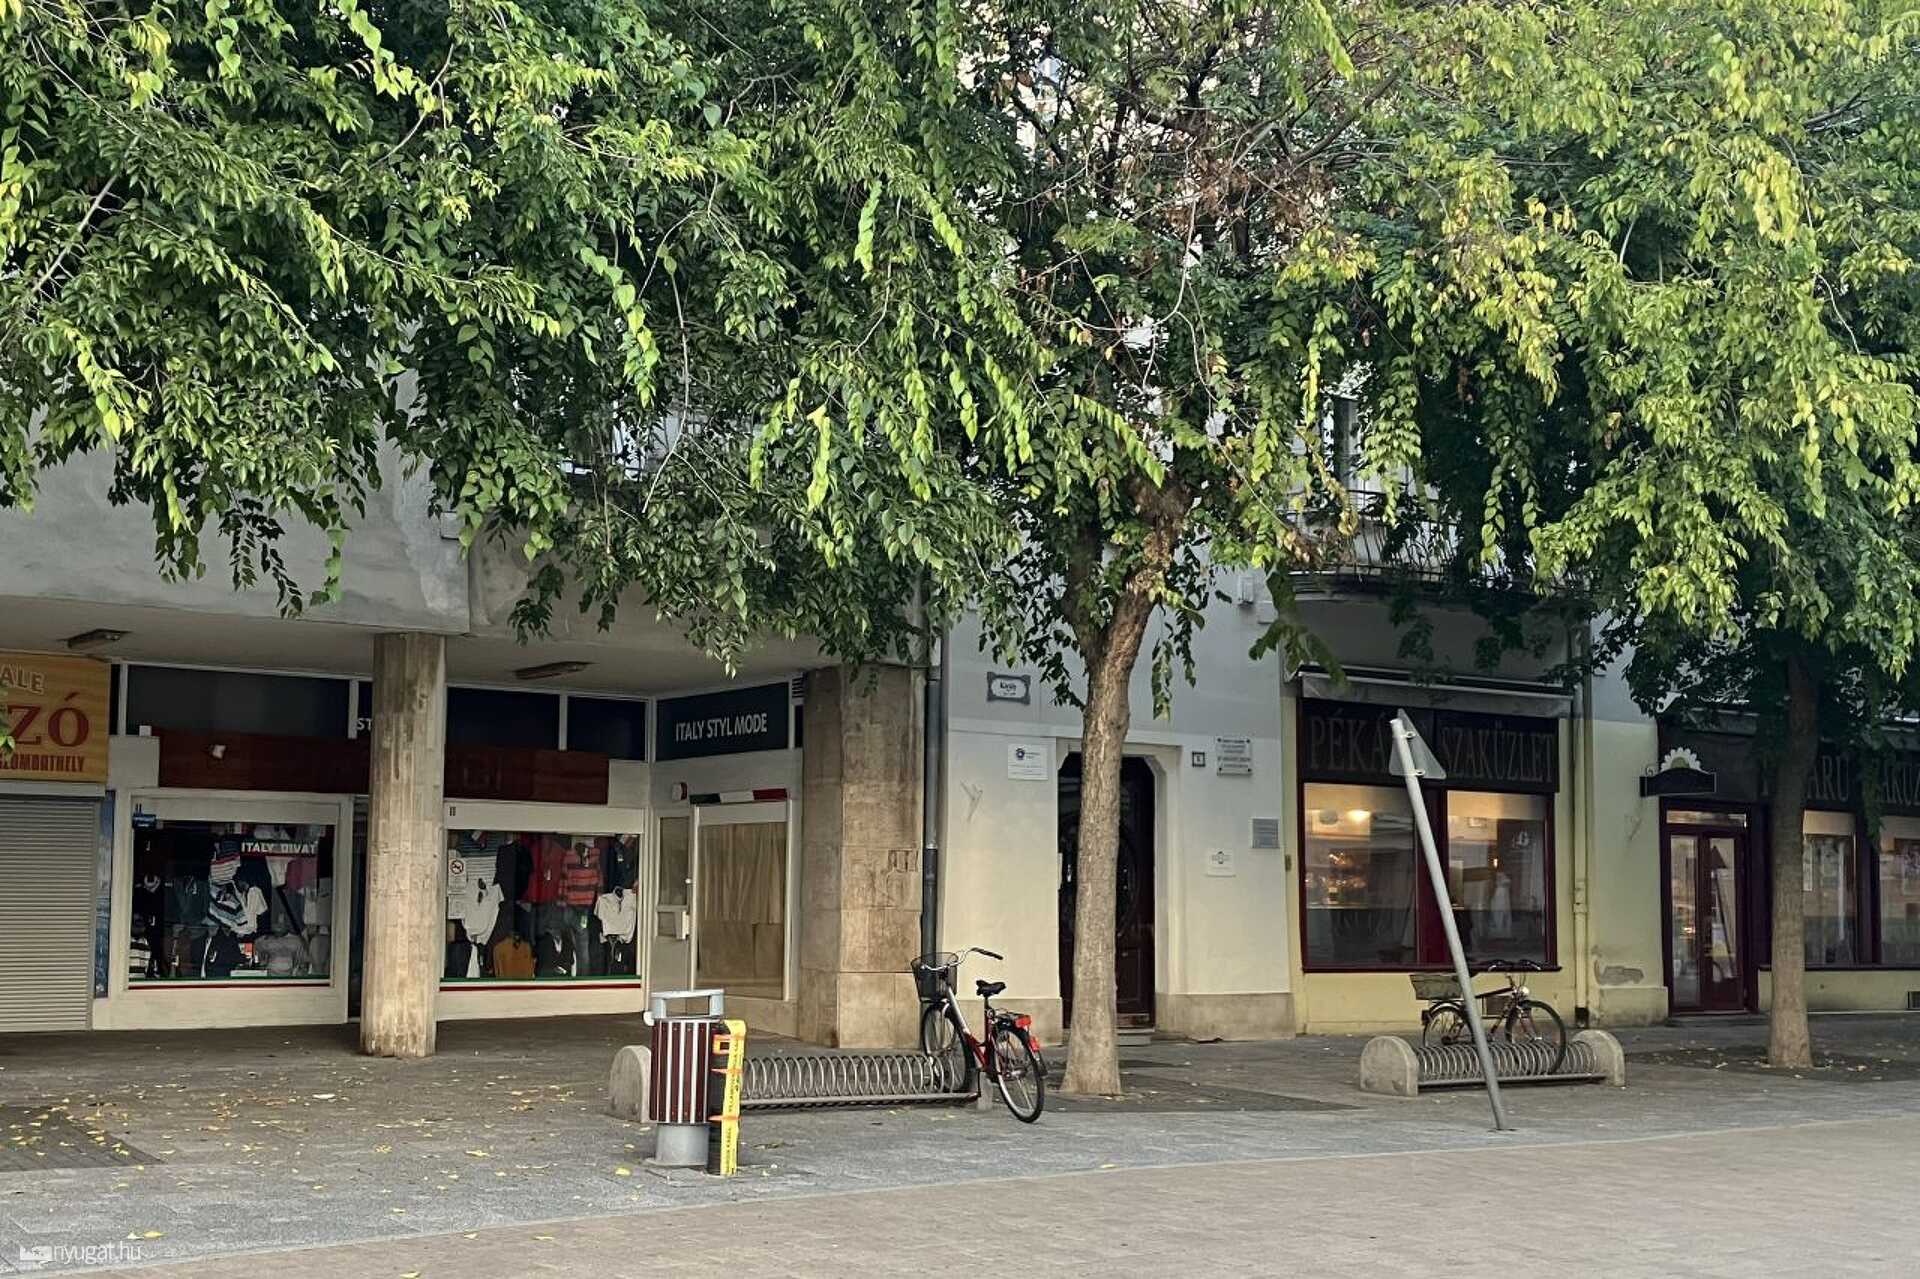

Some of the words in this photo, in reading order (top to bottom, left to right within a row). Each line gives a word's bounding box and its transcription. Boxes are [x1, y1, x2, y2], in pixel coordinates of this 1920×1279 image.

[675, 720, 704, 741] ITALY
[706, 717, 733, 738] STYL
[734, 712, 768, 735] MODE
[241, 841, 274, 854] ITALY
